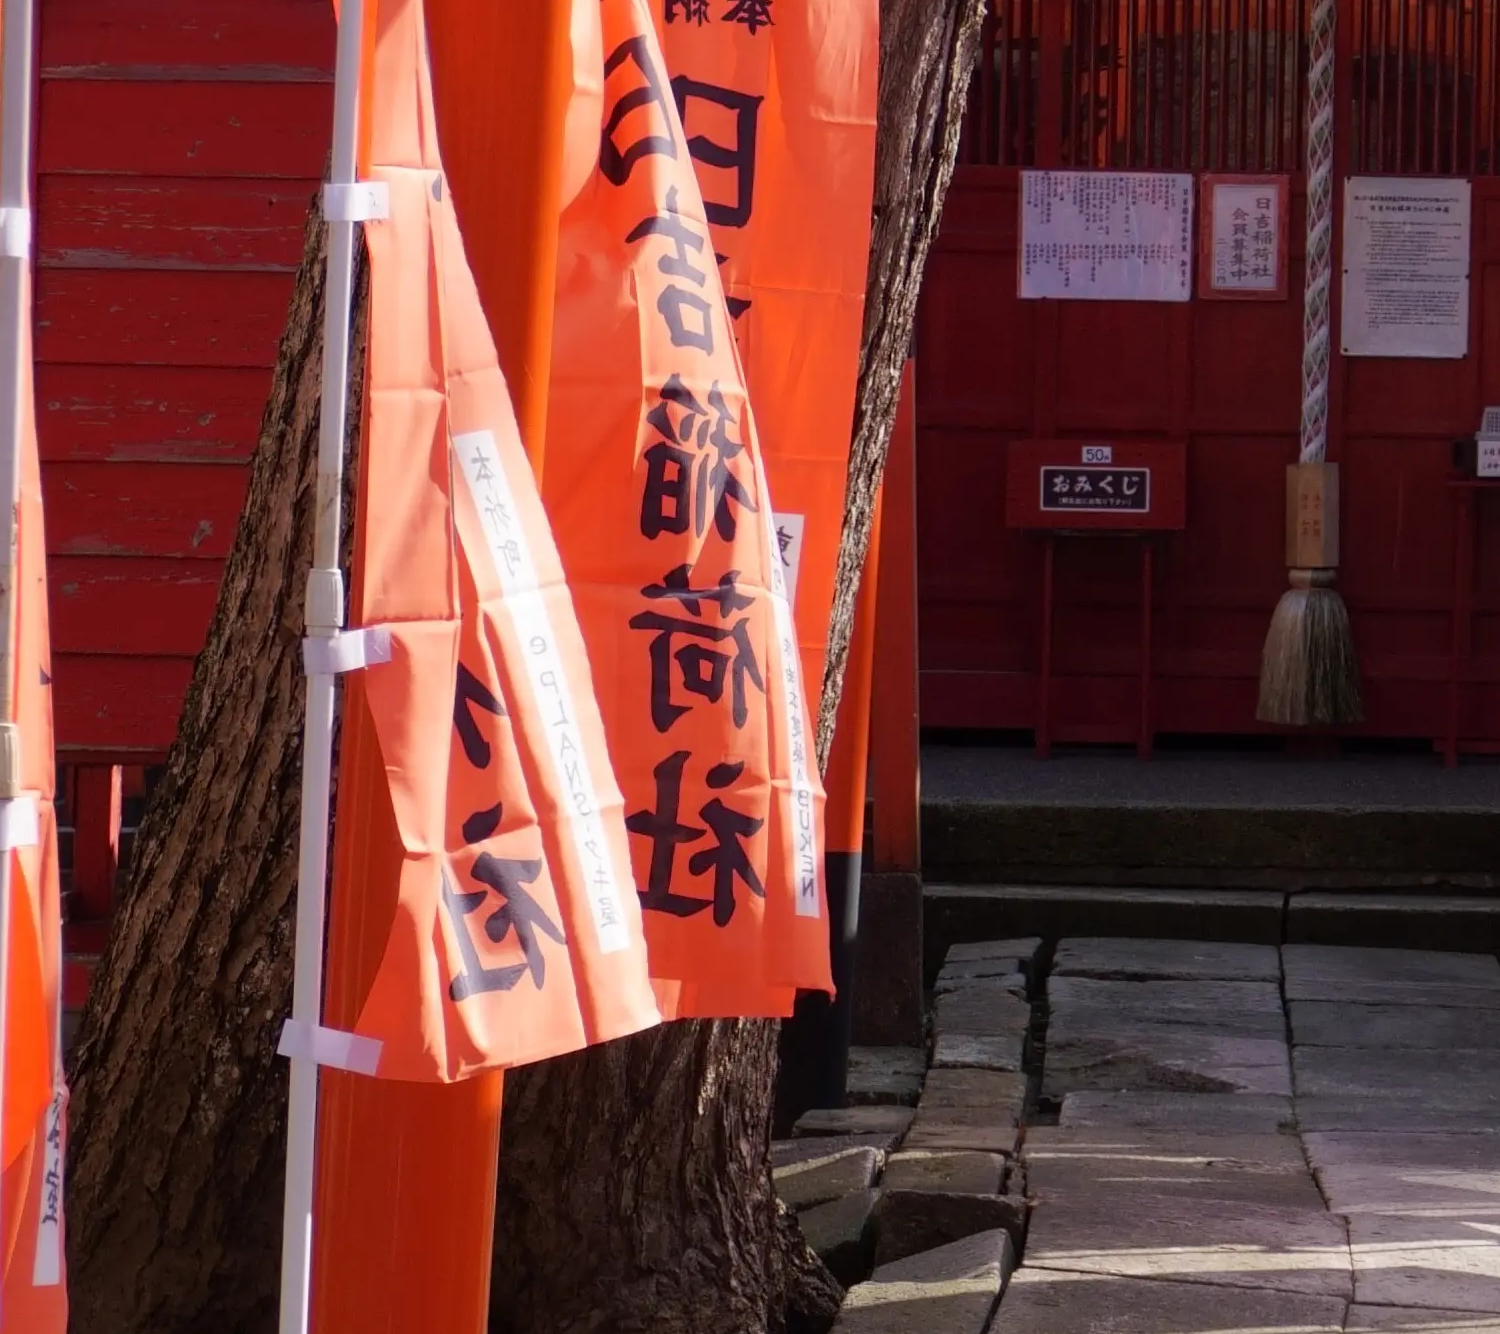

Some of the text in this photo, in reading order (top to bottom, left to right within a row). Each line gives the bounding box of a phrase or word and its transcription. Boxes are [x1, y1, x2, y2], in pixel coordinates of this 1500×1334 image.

[1229, 207, 1250, 281] 会員募集中
[1250, 197, 1274, 279] 日吉稲荷社
[1052, 474, 1140, 495] おみくじ
